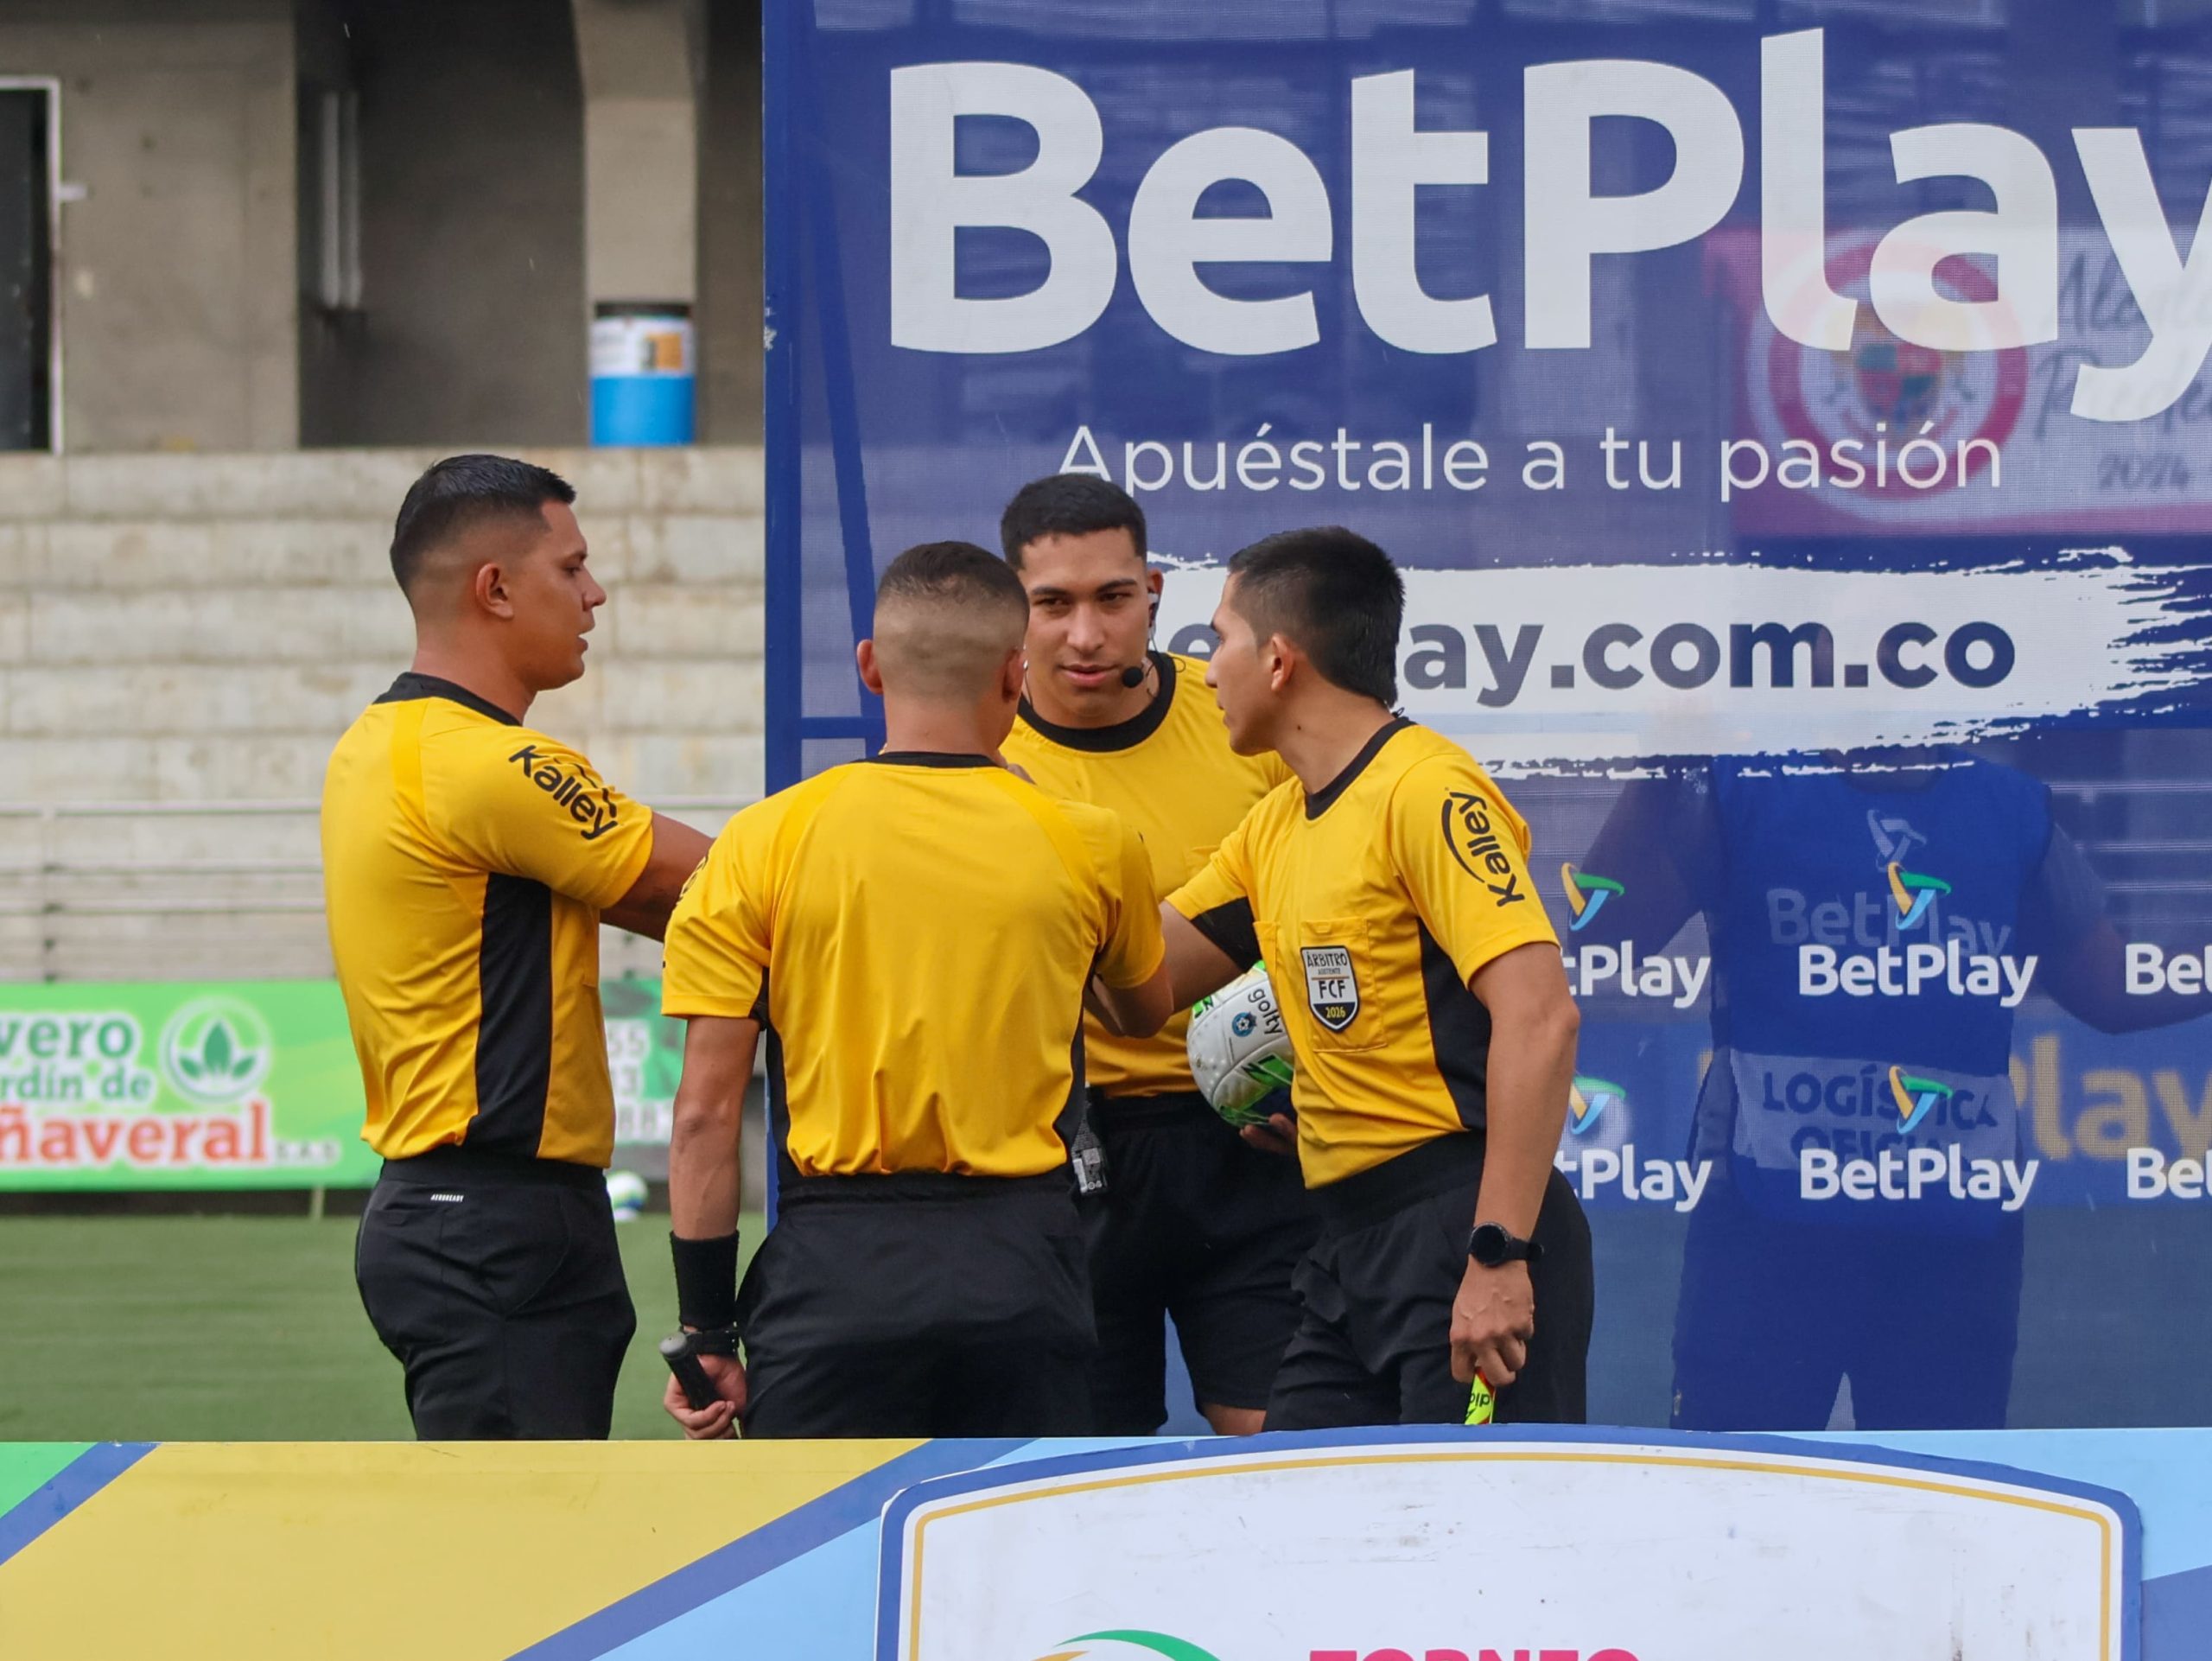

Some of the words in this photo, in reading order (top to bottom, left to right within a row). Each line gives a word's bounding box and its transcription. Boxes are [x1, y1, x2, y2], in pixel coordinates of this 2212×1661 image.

[890, 28, 2212, 423] BetPlay
[1059, 422, 1489, 499] Apuéstale
[1522, 441, 1564, 490] a
[1599, 427, 1681, 490] tu
[1721, 421, 2001, 502] pasión
[1167, 621, 2015, 707] ay.com.co
[508, 744, 618, 840] Kalley
[1448, 792, 1526, 907] Kalley
[1318, 980, 1345, 999] FCF
[1799, 938, 2037, 1007] BetPlay
[1248, 988, 1283, 1035] golty
[101, 1065, 151, 1101] de
[1763, 1063, 1998, 1130] LOGÍSICA
[2009, 1034, 2212, 1162] lay
[1800, 1142, 2038, 1212] BetPlay
